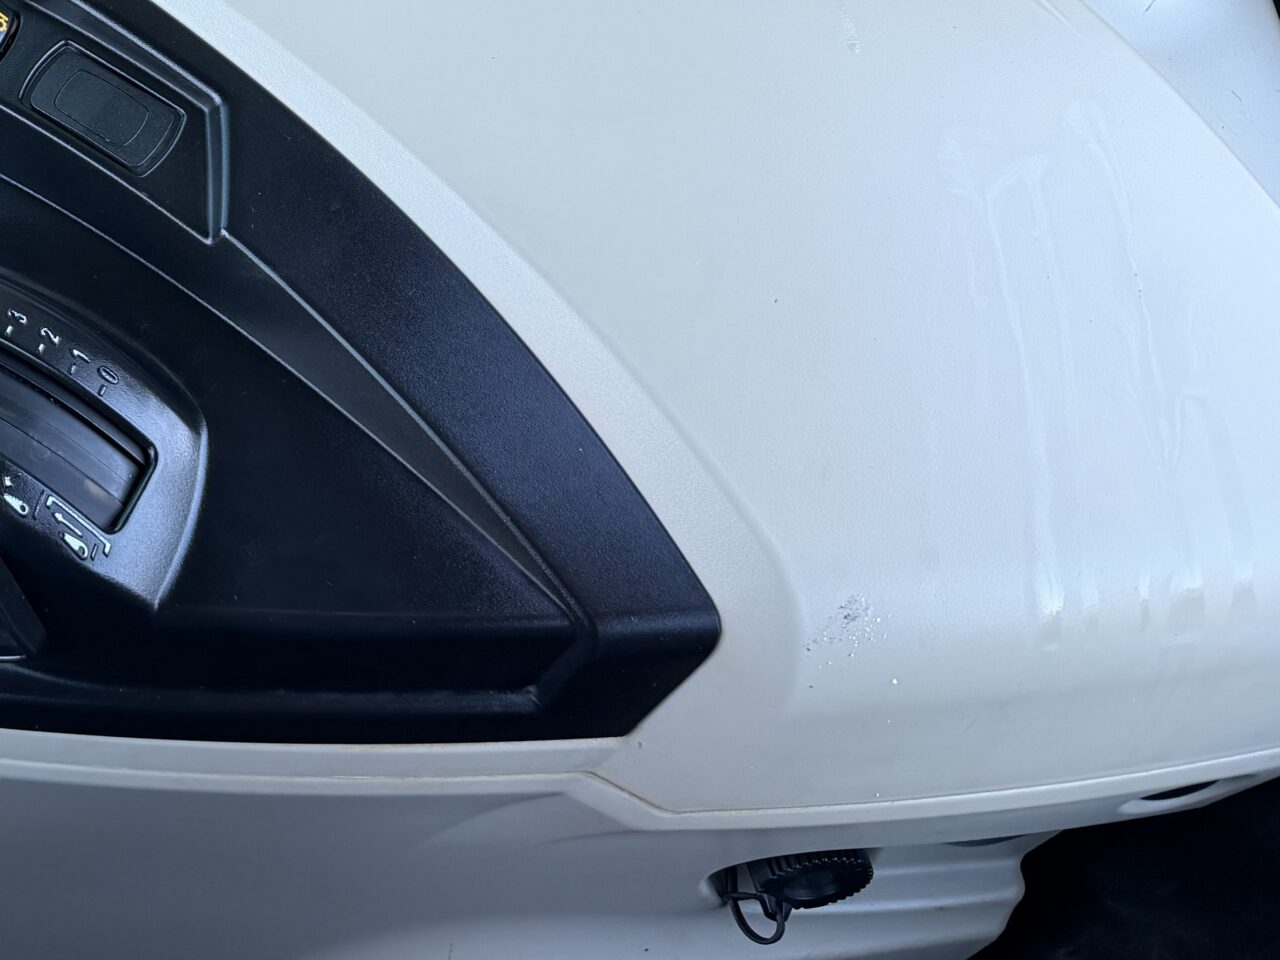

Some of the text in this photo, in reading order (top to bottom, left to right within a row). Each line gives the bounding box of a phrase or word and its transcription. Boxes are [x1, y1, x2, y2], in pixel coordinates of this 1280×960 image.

[8, 309, 27, 325] 3
[41, 328, 61, 345] 2
[72, 349, 91, 363] 1
[98, 366, 119, 384] 0
